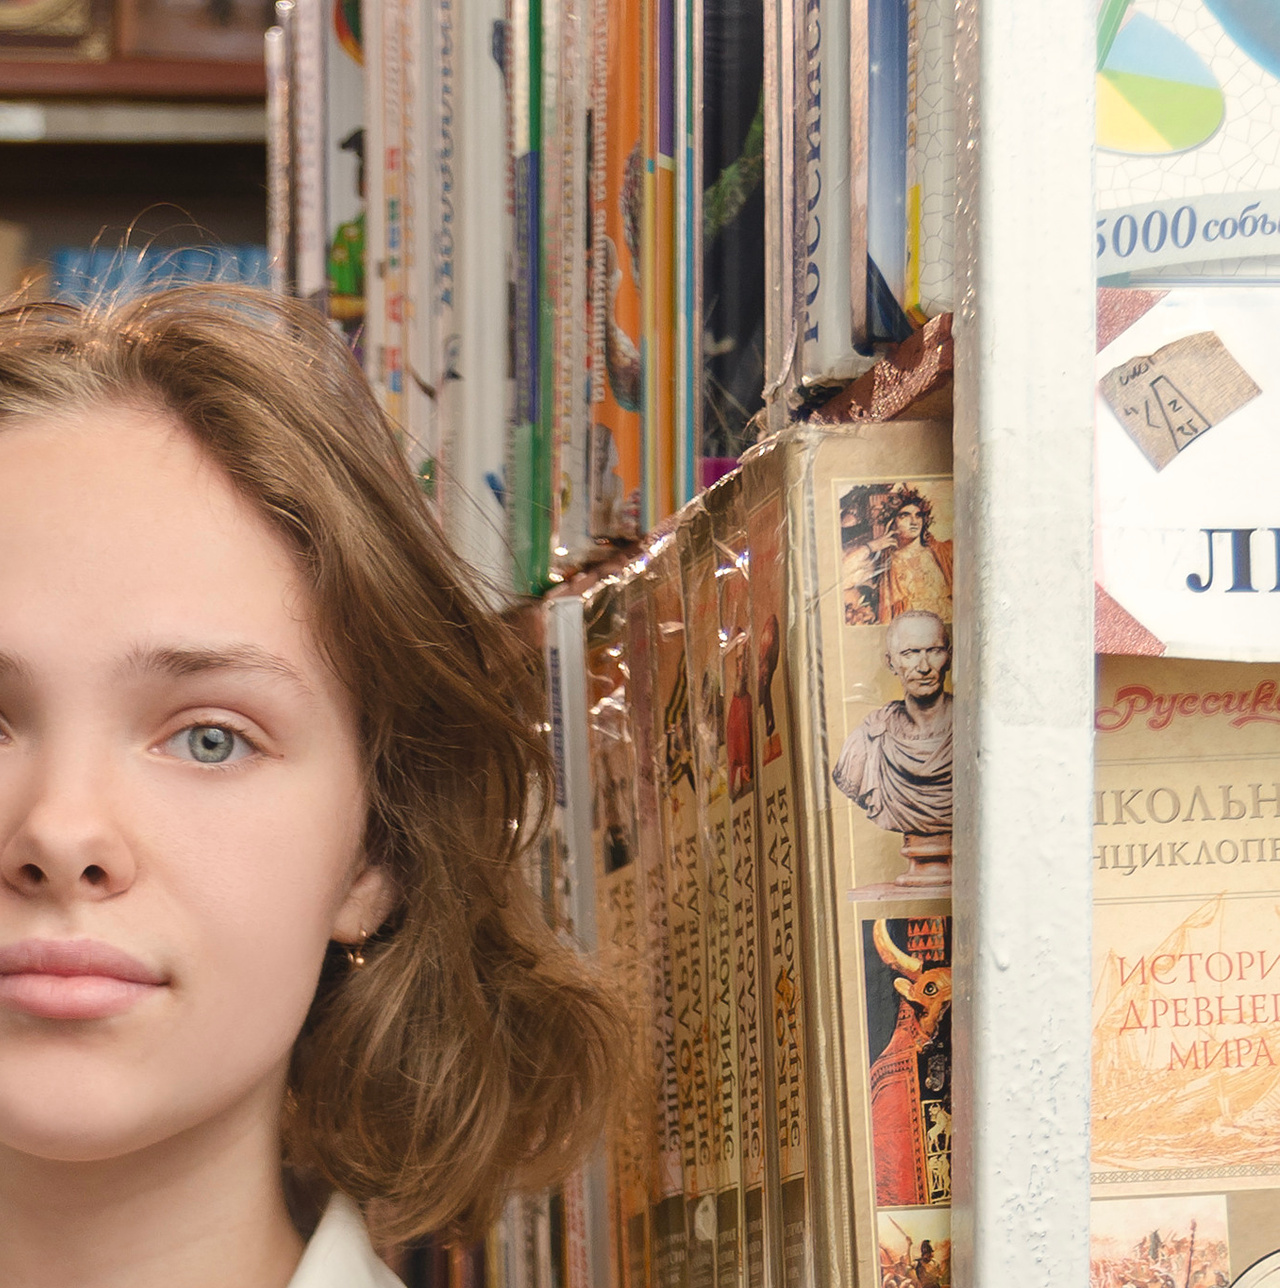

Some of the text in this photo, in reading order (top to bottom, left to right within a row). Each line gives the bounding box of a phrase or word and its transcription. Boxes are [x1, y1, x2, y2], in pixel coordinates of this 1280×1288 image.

[716, 820, 736, 1161] ЭНЦИКЛОПЕДИЯ
[743, 806, 760, 1159] ЭНЦИКЛОПЕДИЯ
[766, 789, 788, 1149] ШКОЛЬНАЯ
[778, 785, 802, 1148] ЭНЦИКЛОПЕДИЯ
[1168, 1036, 1277, 1072] МИРА
